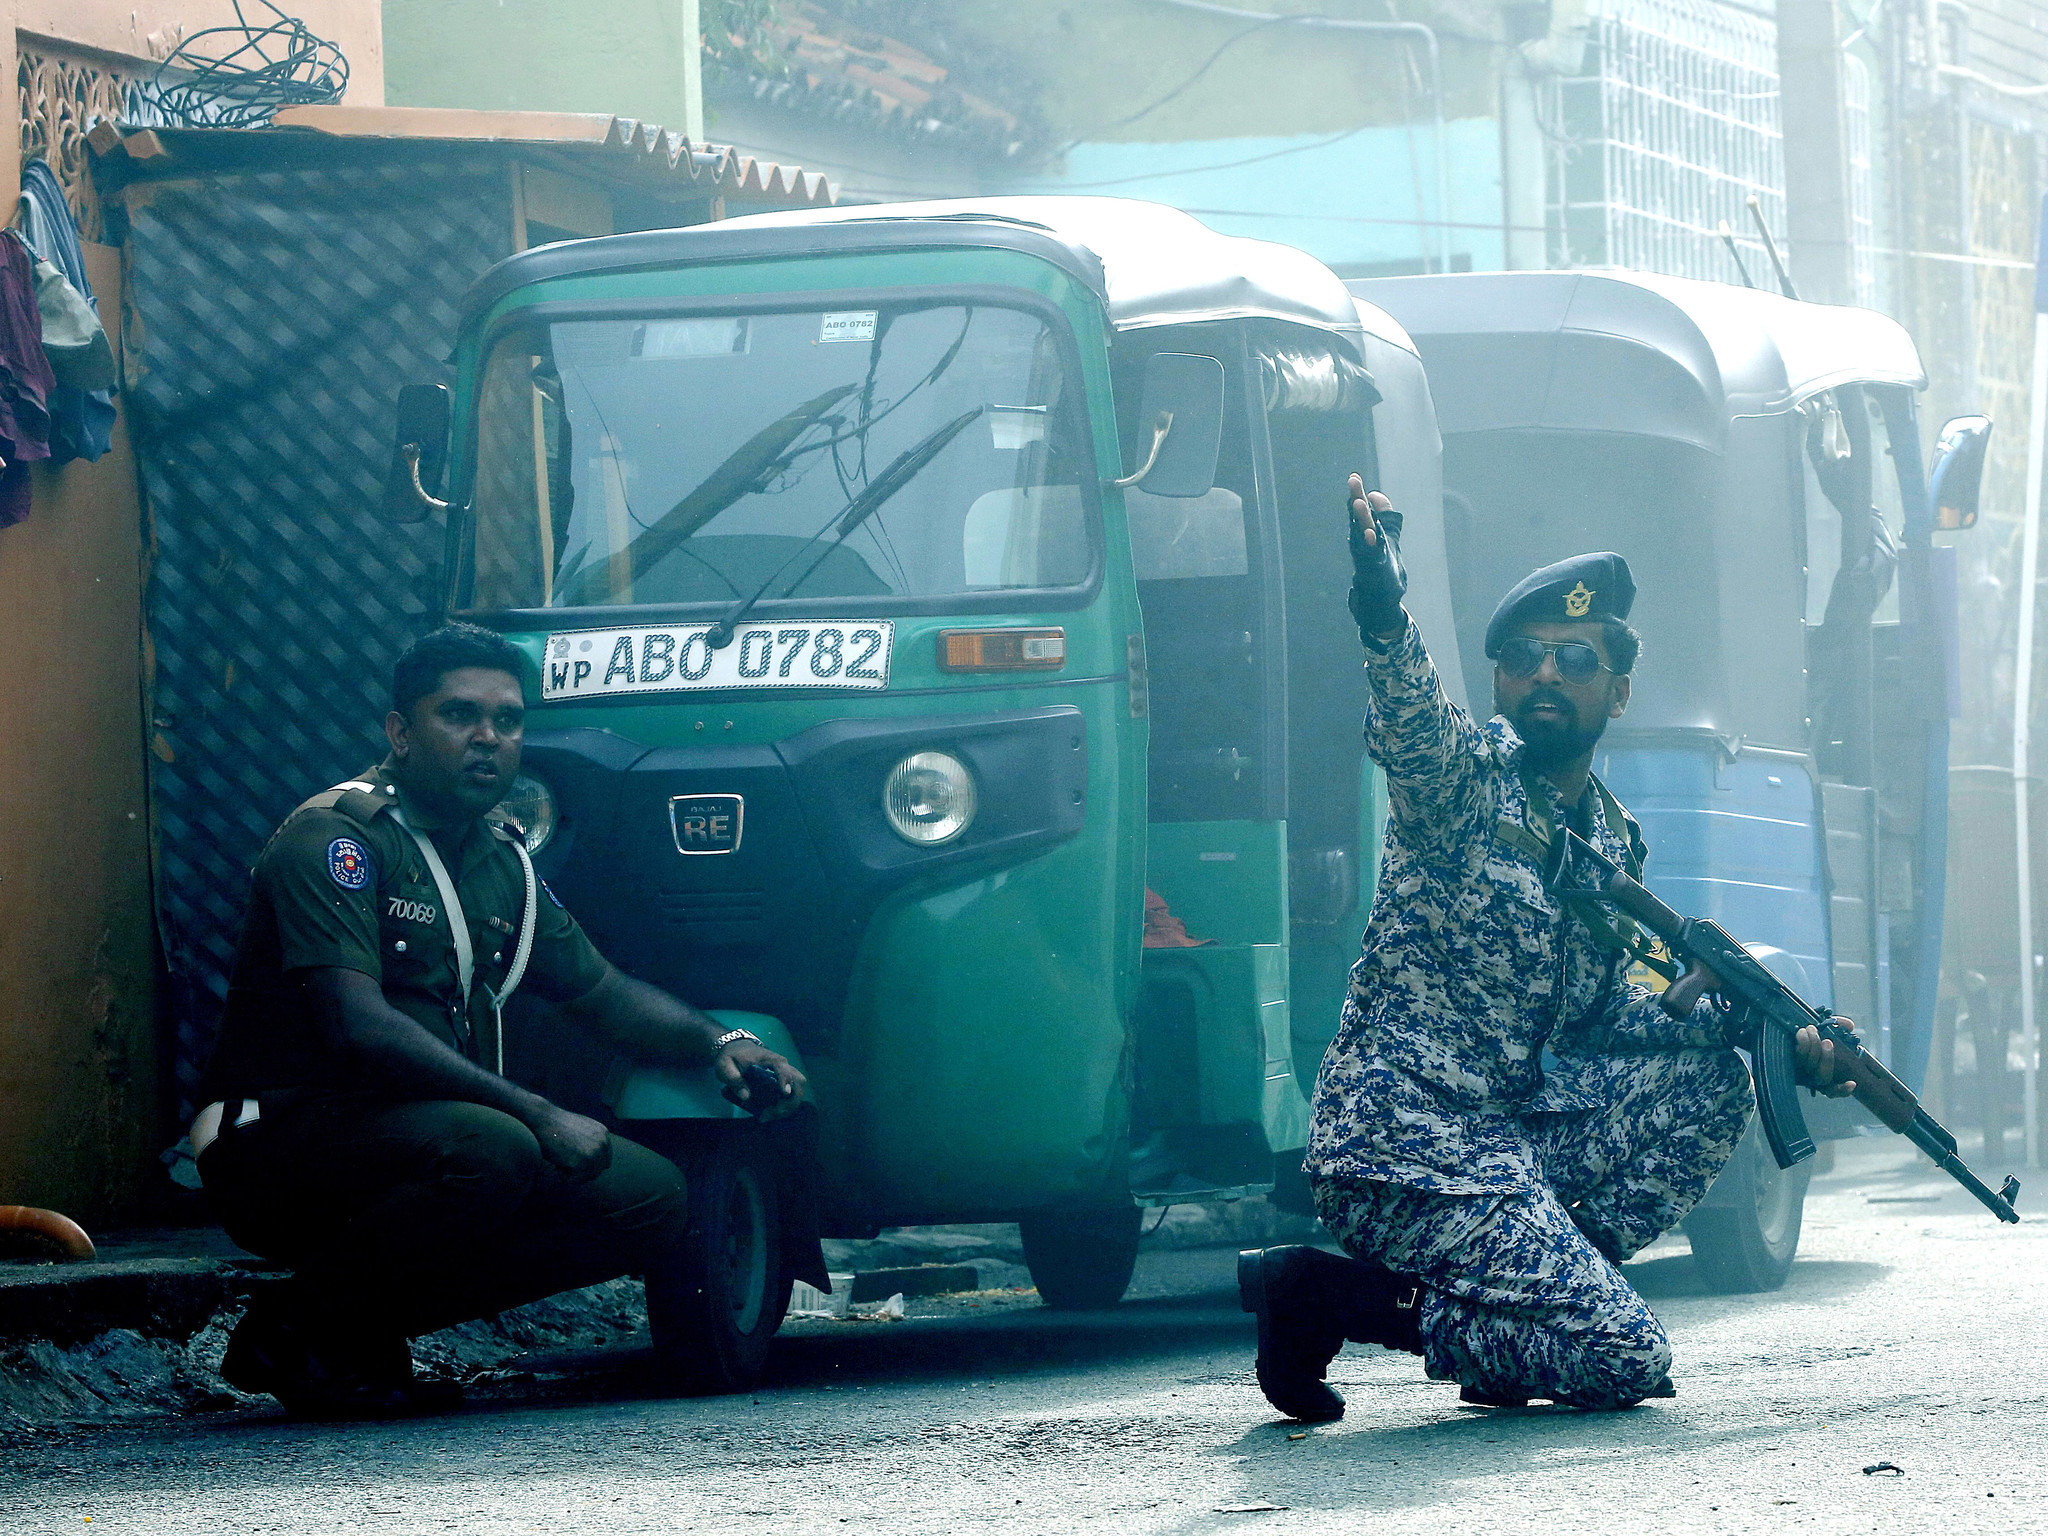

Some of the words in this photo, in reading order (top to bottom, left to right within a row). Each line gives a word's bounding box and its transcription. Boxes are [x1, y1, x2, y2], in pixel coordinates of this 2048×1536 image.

[825, 321, 847, 329] ABO
[849, 320, 873, 328] 0782
[551, 661, 592, 690] WP
[604, 632, 715, 684] ABO
[738, 629, 882, 679] 0782
[684, 815, 731, 841] RE
[388, 897, 436, 924] 70069
